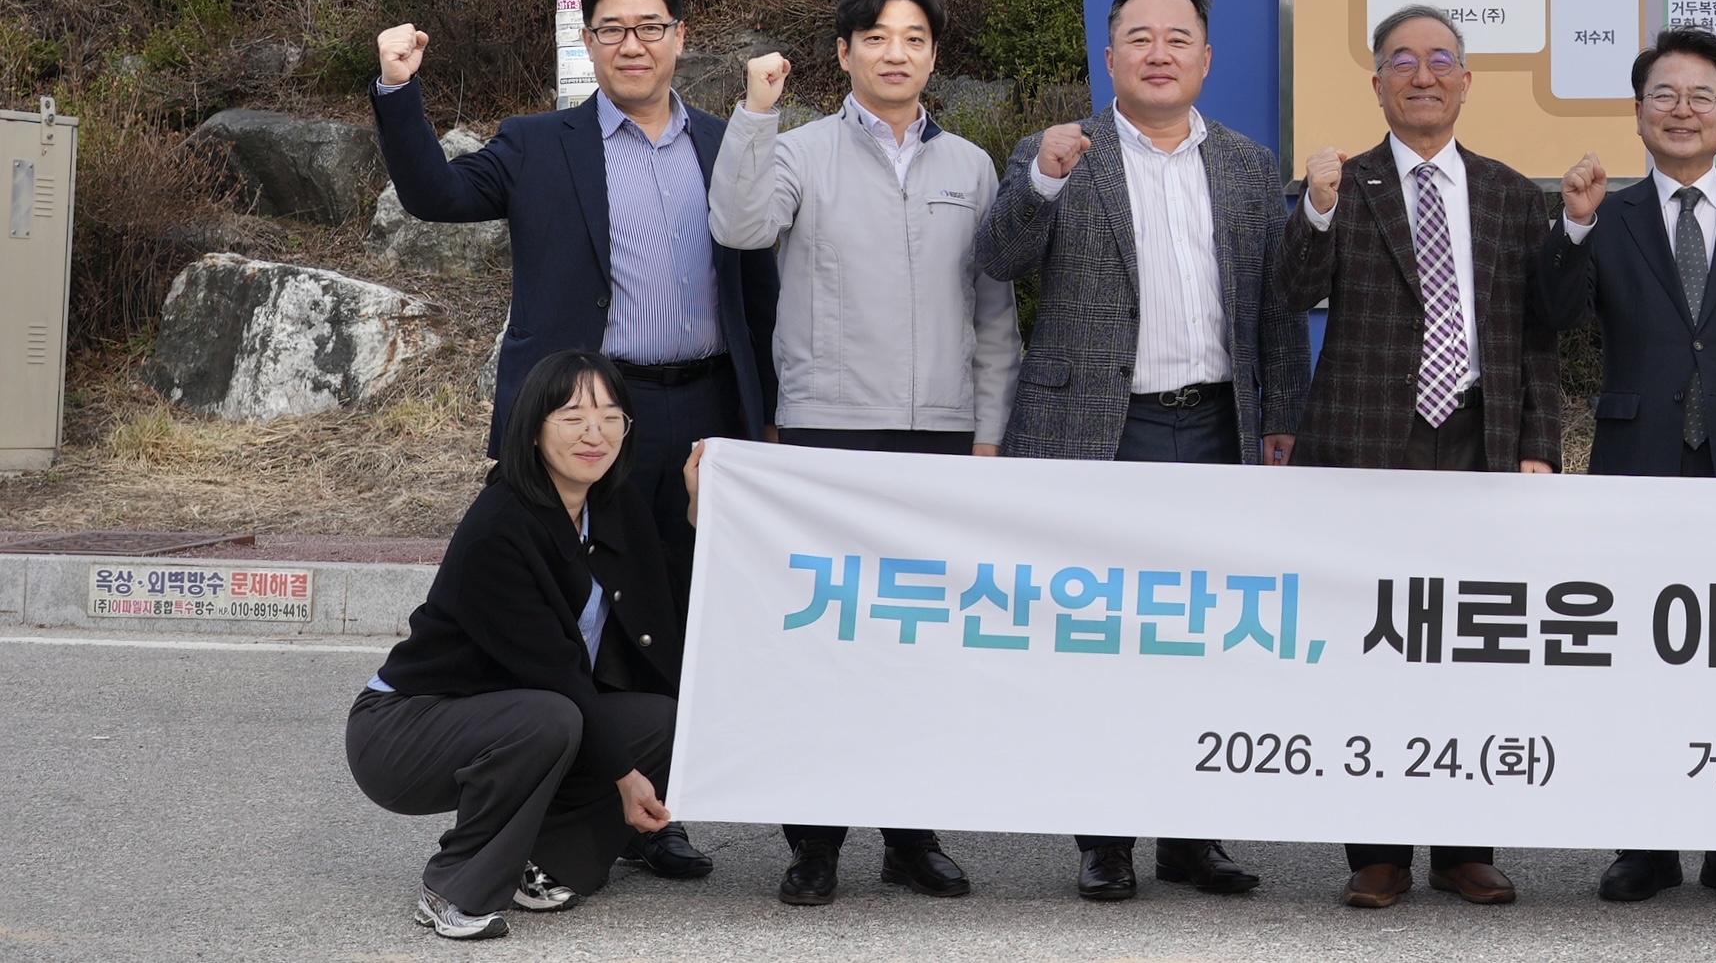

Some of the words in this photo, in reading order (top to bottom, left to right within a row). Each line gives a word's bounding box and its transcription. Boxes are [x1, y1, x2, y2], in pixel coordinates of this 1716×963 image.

[1481, 7, 1506, 25] (주)
[1574, 29, 1615, 46] 저수지
[230, 572, 308, 599] 문제해결
[230, 602, 308, 618] 010-8919-4416
[783, 553, 1326, 664] 거두산업단지,
[1362, 576, 1618, 667] 새로운
[1195, 731, 1324, 778] 2026.
[1344, 735, 1384, 779] 3.
[1404, 734, 1555, 787] 24.(화)
